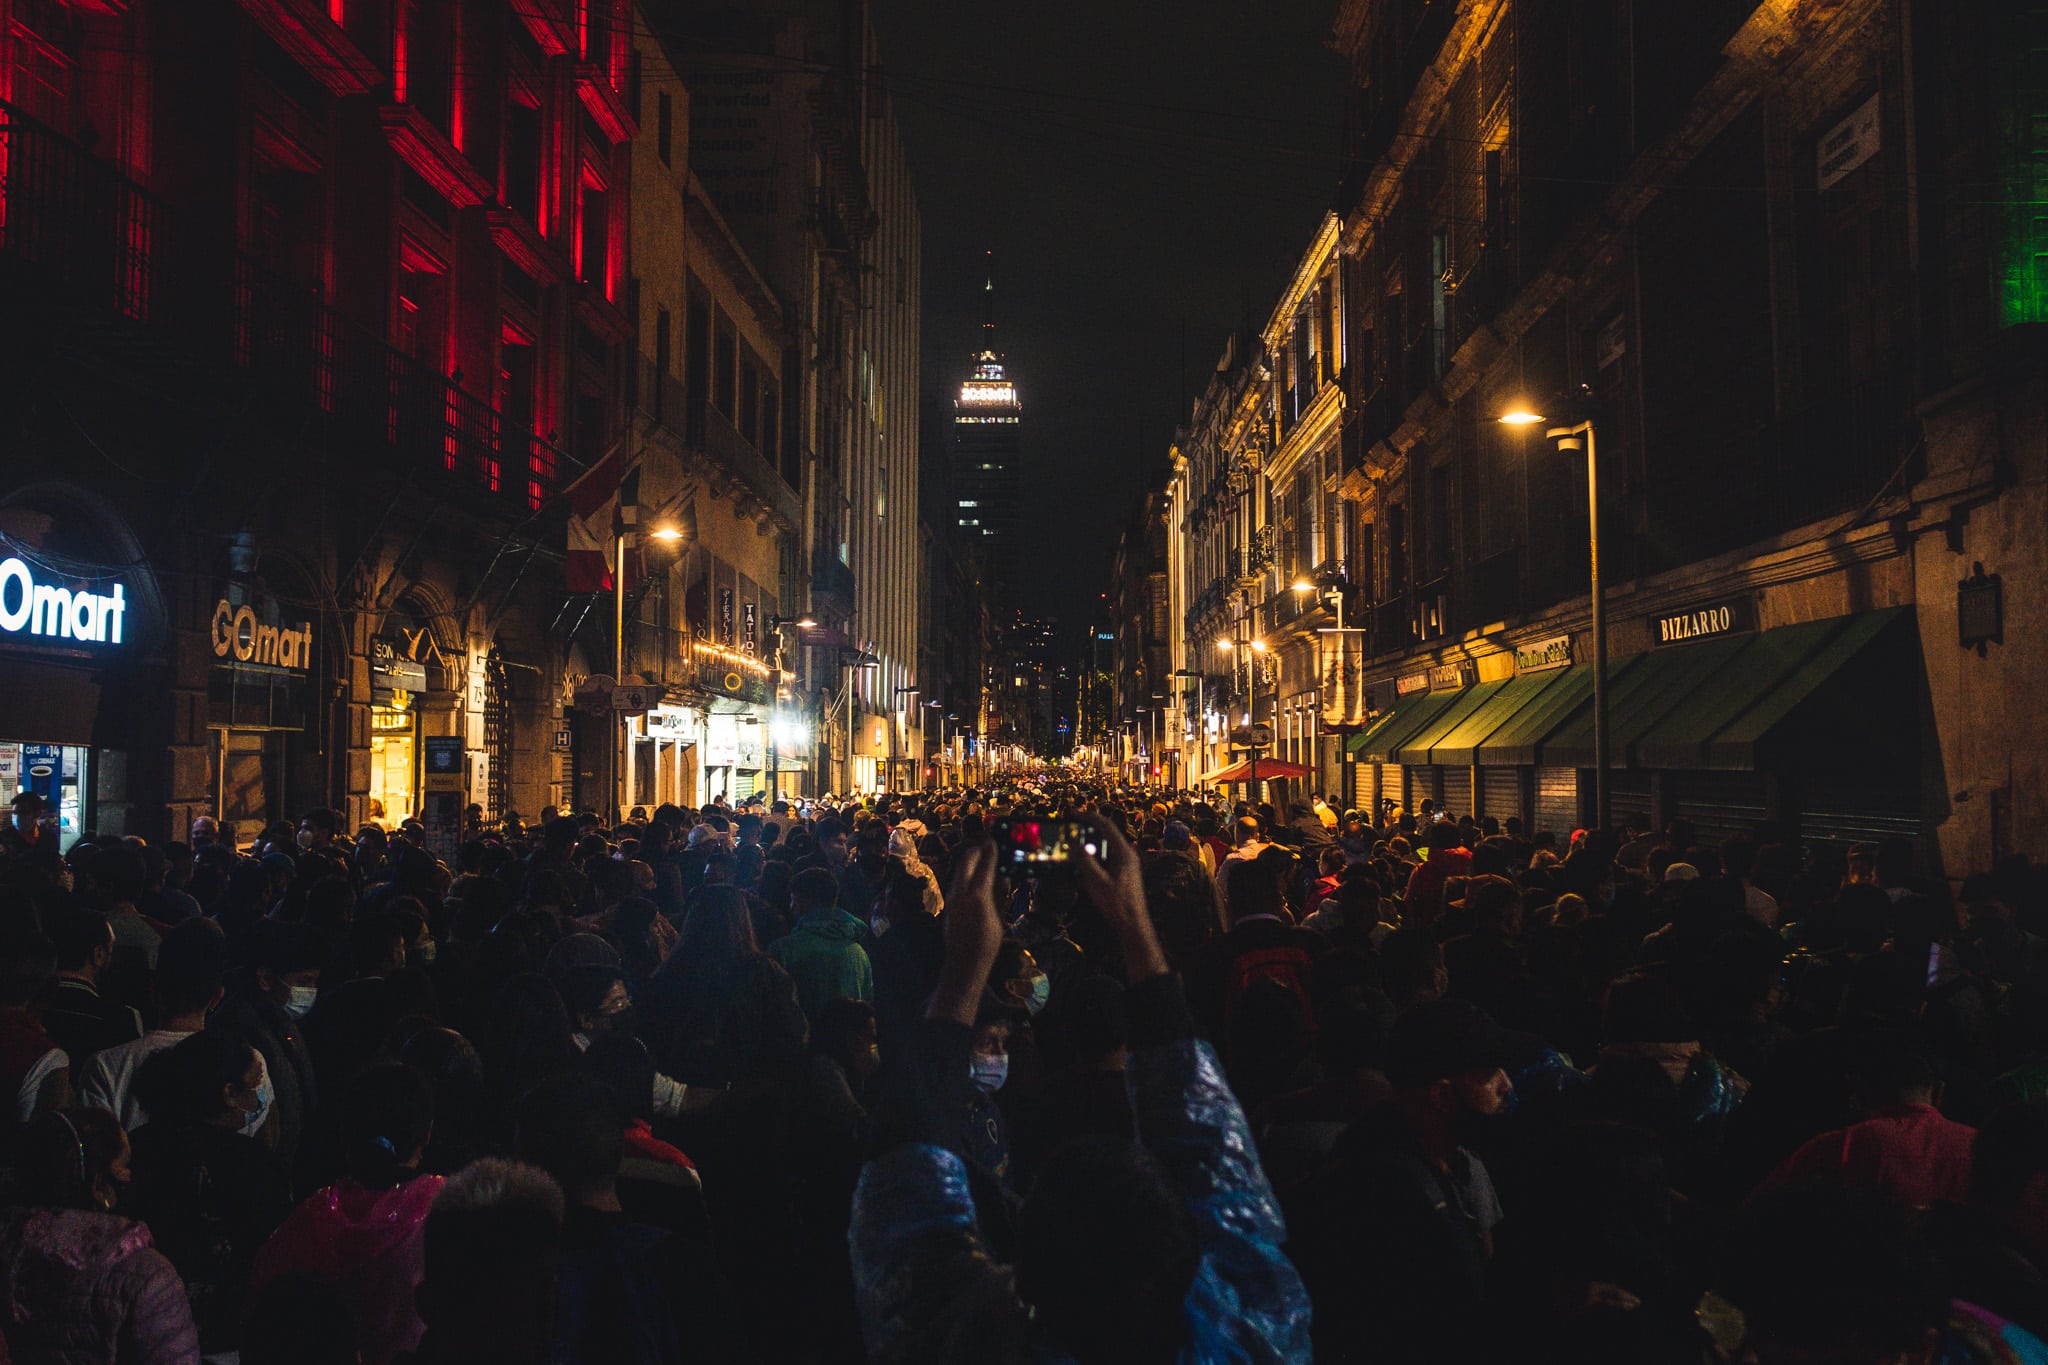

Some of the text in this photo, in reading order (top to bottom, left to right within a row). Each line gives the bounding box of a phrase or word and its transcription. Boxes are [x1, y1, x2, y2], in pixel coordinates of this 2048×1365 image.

[0, 557, 126, 644] Omart
[211, 598, 312, 669] GOmart
[1660, 606, 1730, 641] BIZZARRO
[384, 664, 404, 677] PARIS
[557, 733, 568, 745] H
[46, 745, 60, 758] $14
